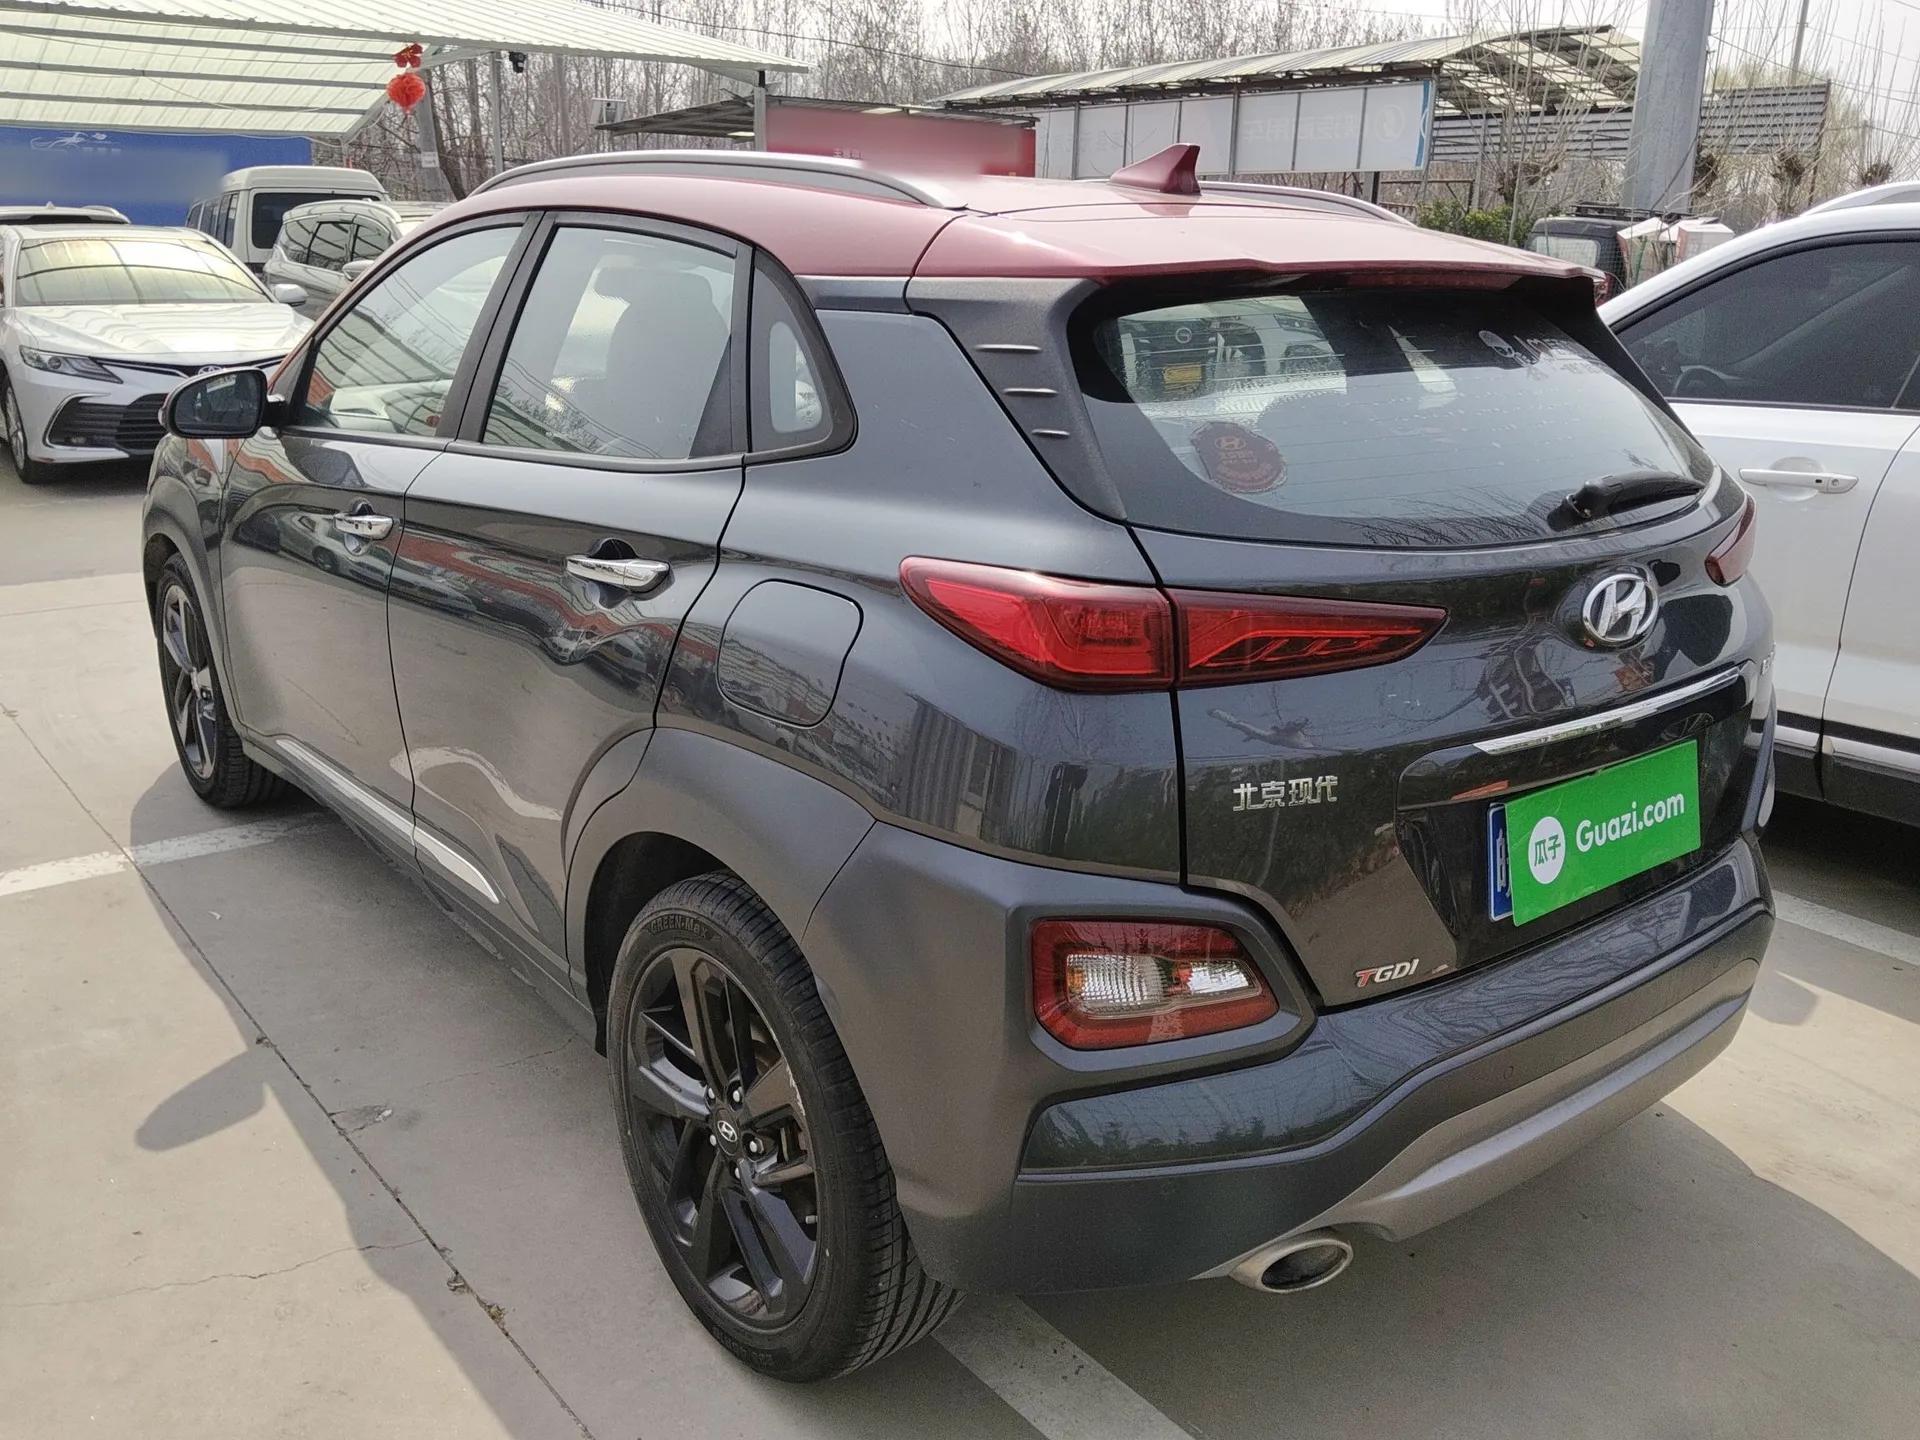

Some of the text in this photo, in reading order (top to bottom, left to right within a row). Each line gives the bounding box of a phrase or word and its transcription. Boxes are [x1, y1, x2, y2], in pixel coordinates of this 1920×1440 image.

[1233, 775, 1338, 811] 北京现代
[1576, 793, 1685, 852] Guazi.com
[1534, 834, 1561, 866] 瓜子
[1356, 958, 1419, 987] TGDI
